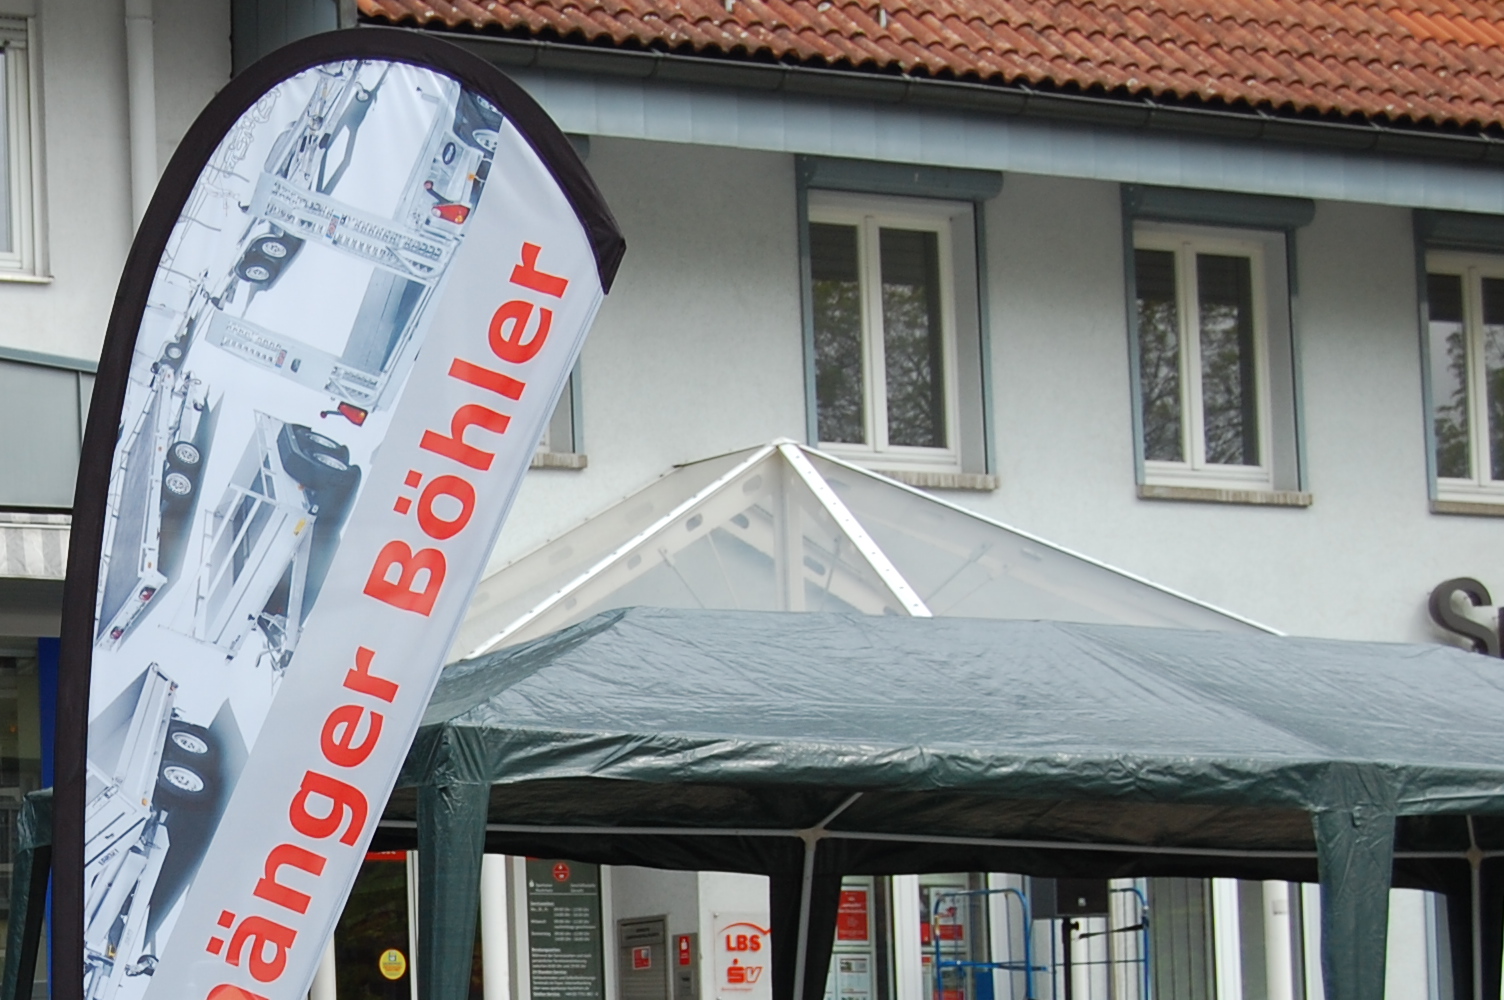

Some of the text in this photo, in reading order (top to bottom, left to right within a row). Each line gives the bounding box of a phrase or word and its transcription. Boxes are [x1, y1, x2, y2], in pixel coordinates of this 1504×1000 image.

[365, 243, 568, 616] Böhler
[1428, 577, 1504, 659] S
[726, 934, 762, 952] LBS
